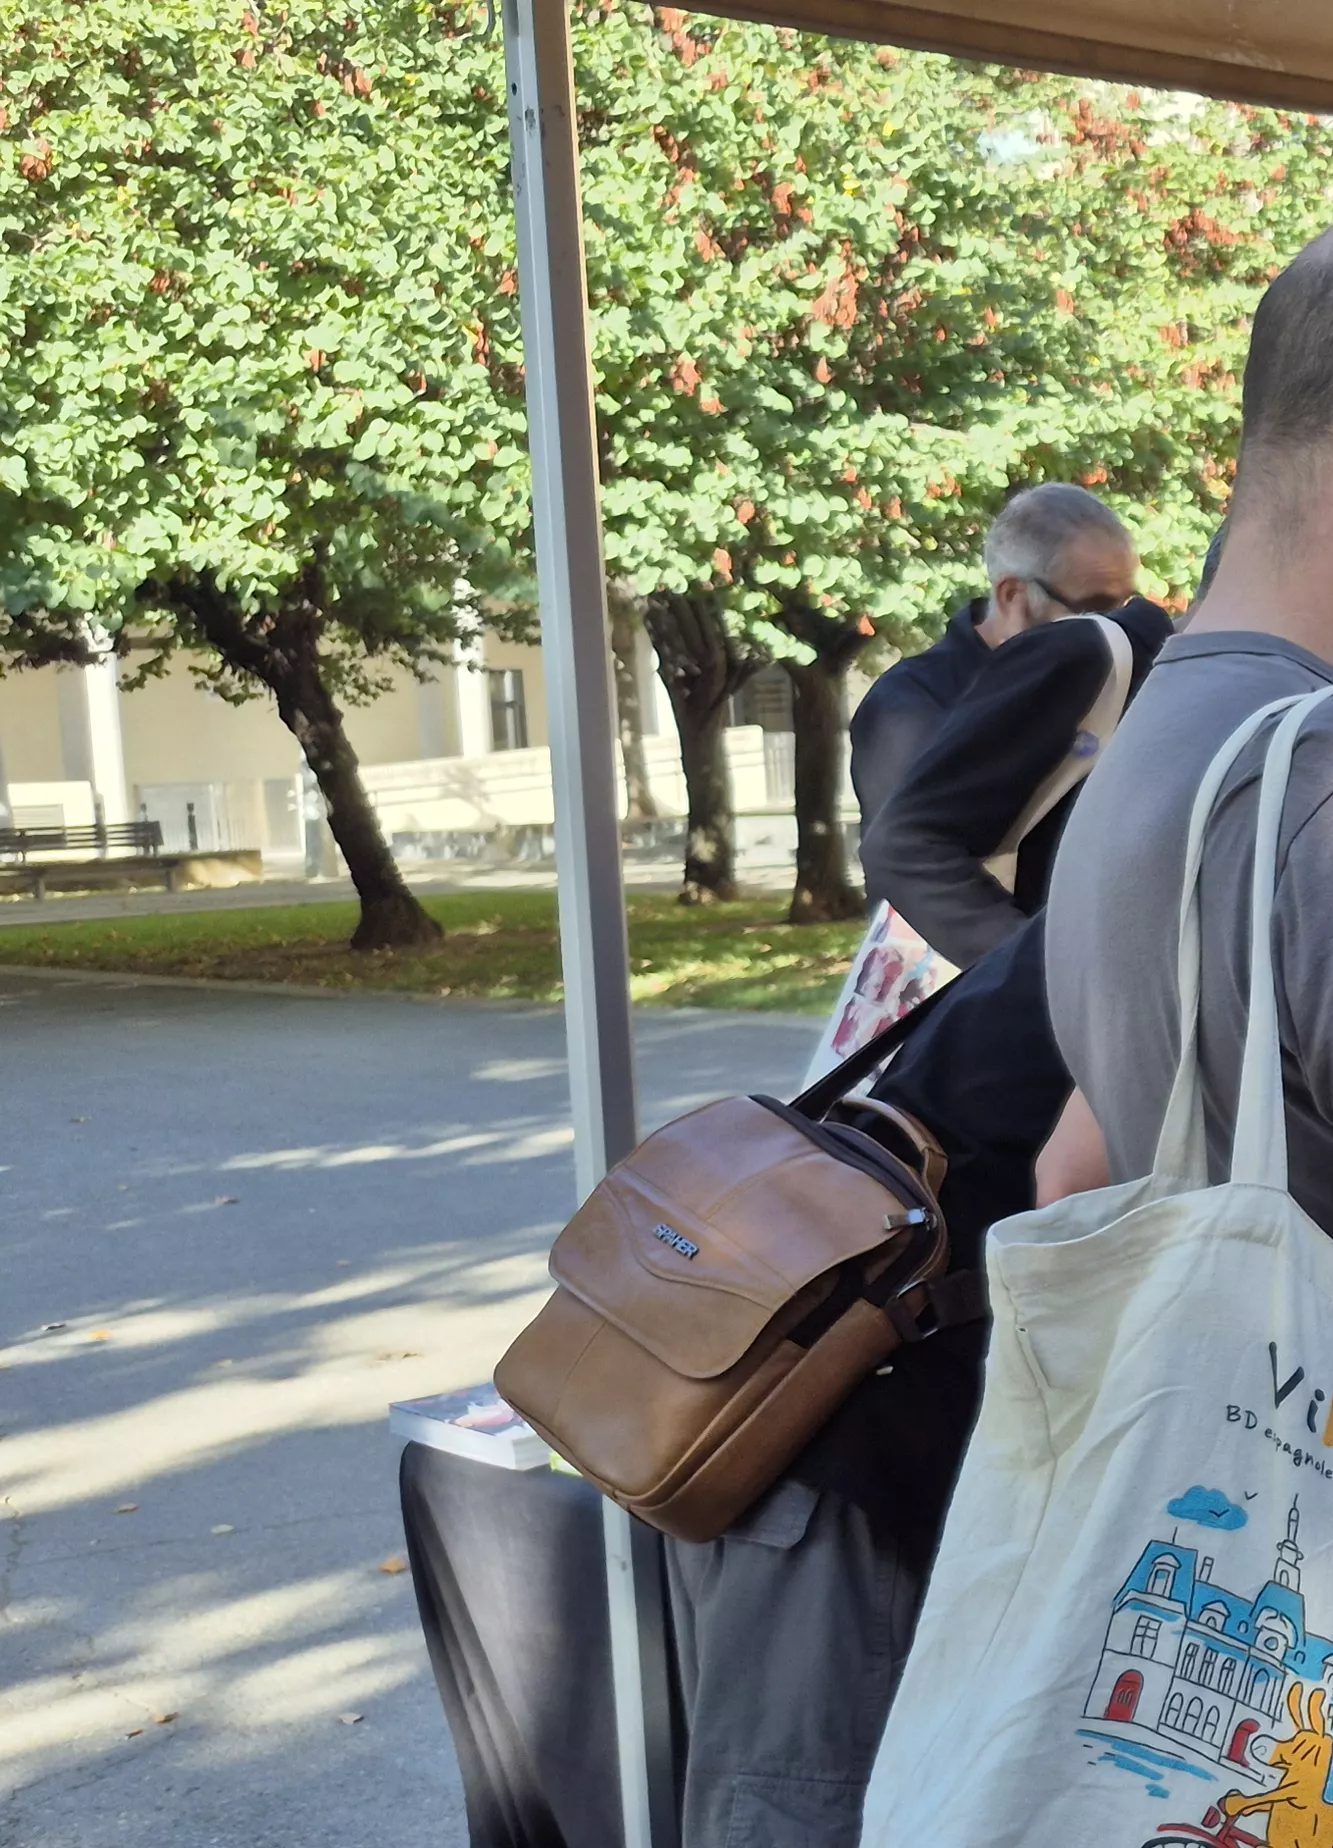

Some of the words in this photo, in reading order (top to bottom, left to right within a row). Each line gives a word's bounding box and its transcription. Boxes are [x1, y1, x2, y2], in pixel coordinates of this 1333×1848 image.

[653, 1223, 699, 1259] SPAHER
[1226, 1404, 1259, 1430] BD
[1264, 1427, 1333, 1480] espagnole
